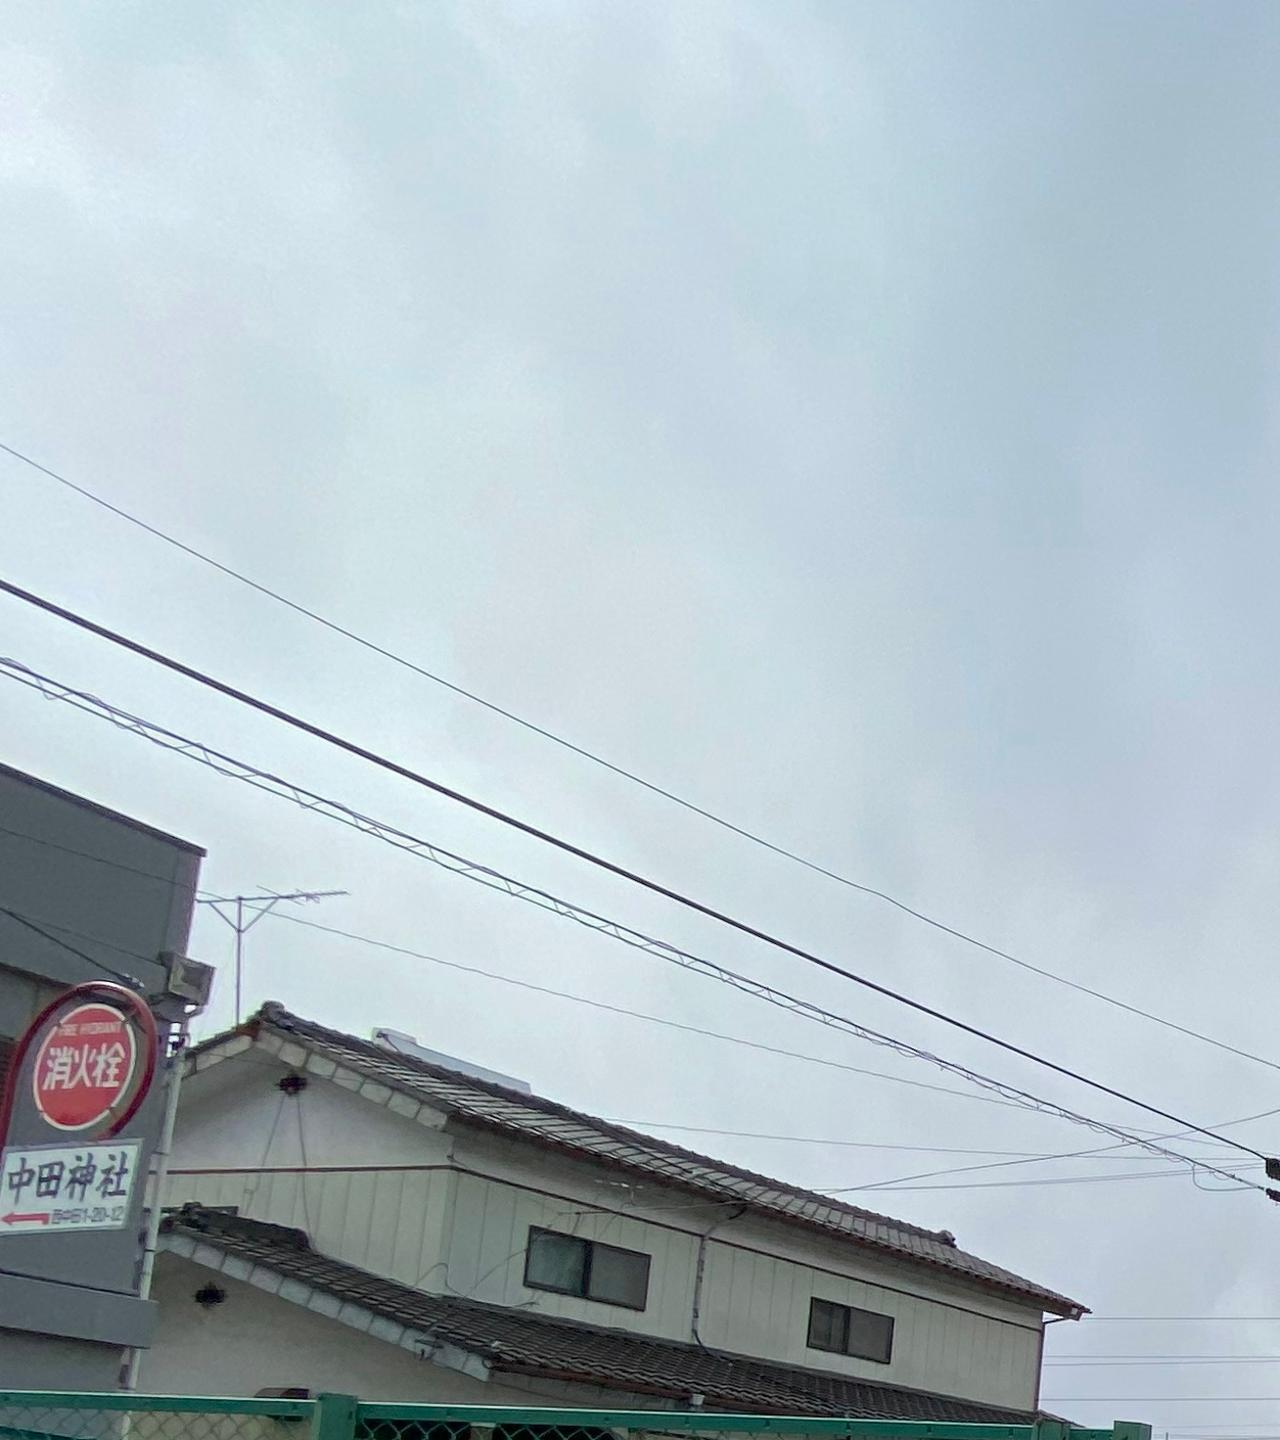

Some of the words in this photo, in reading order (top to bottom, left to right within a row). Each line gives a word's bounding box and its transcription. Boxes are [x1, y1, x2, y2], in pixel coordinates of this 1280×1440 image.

[42, 1041, 125, 1091] 消火栓
[8, 1151, 128, 1204] 中田神社
